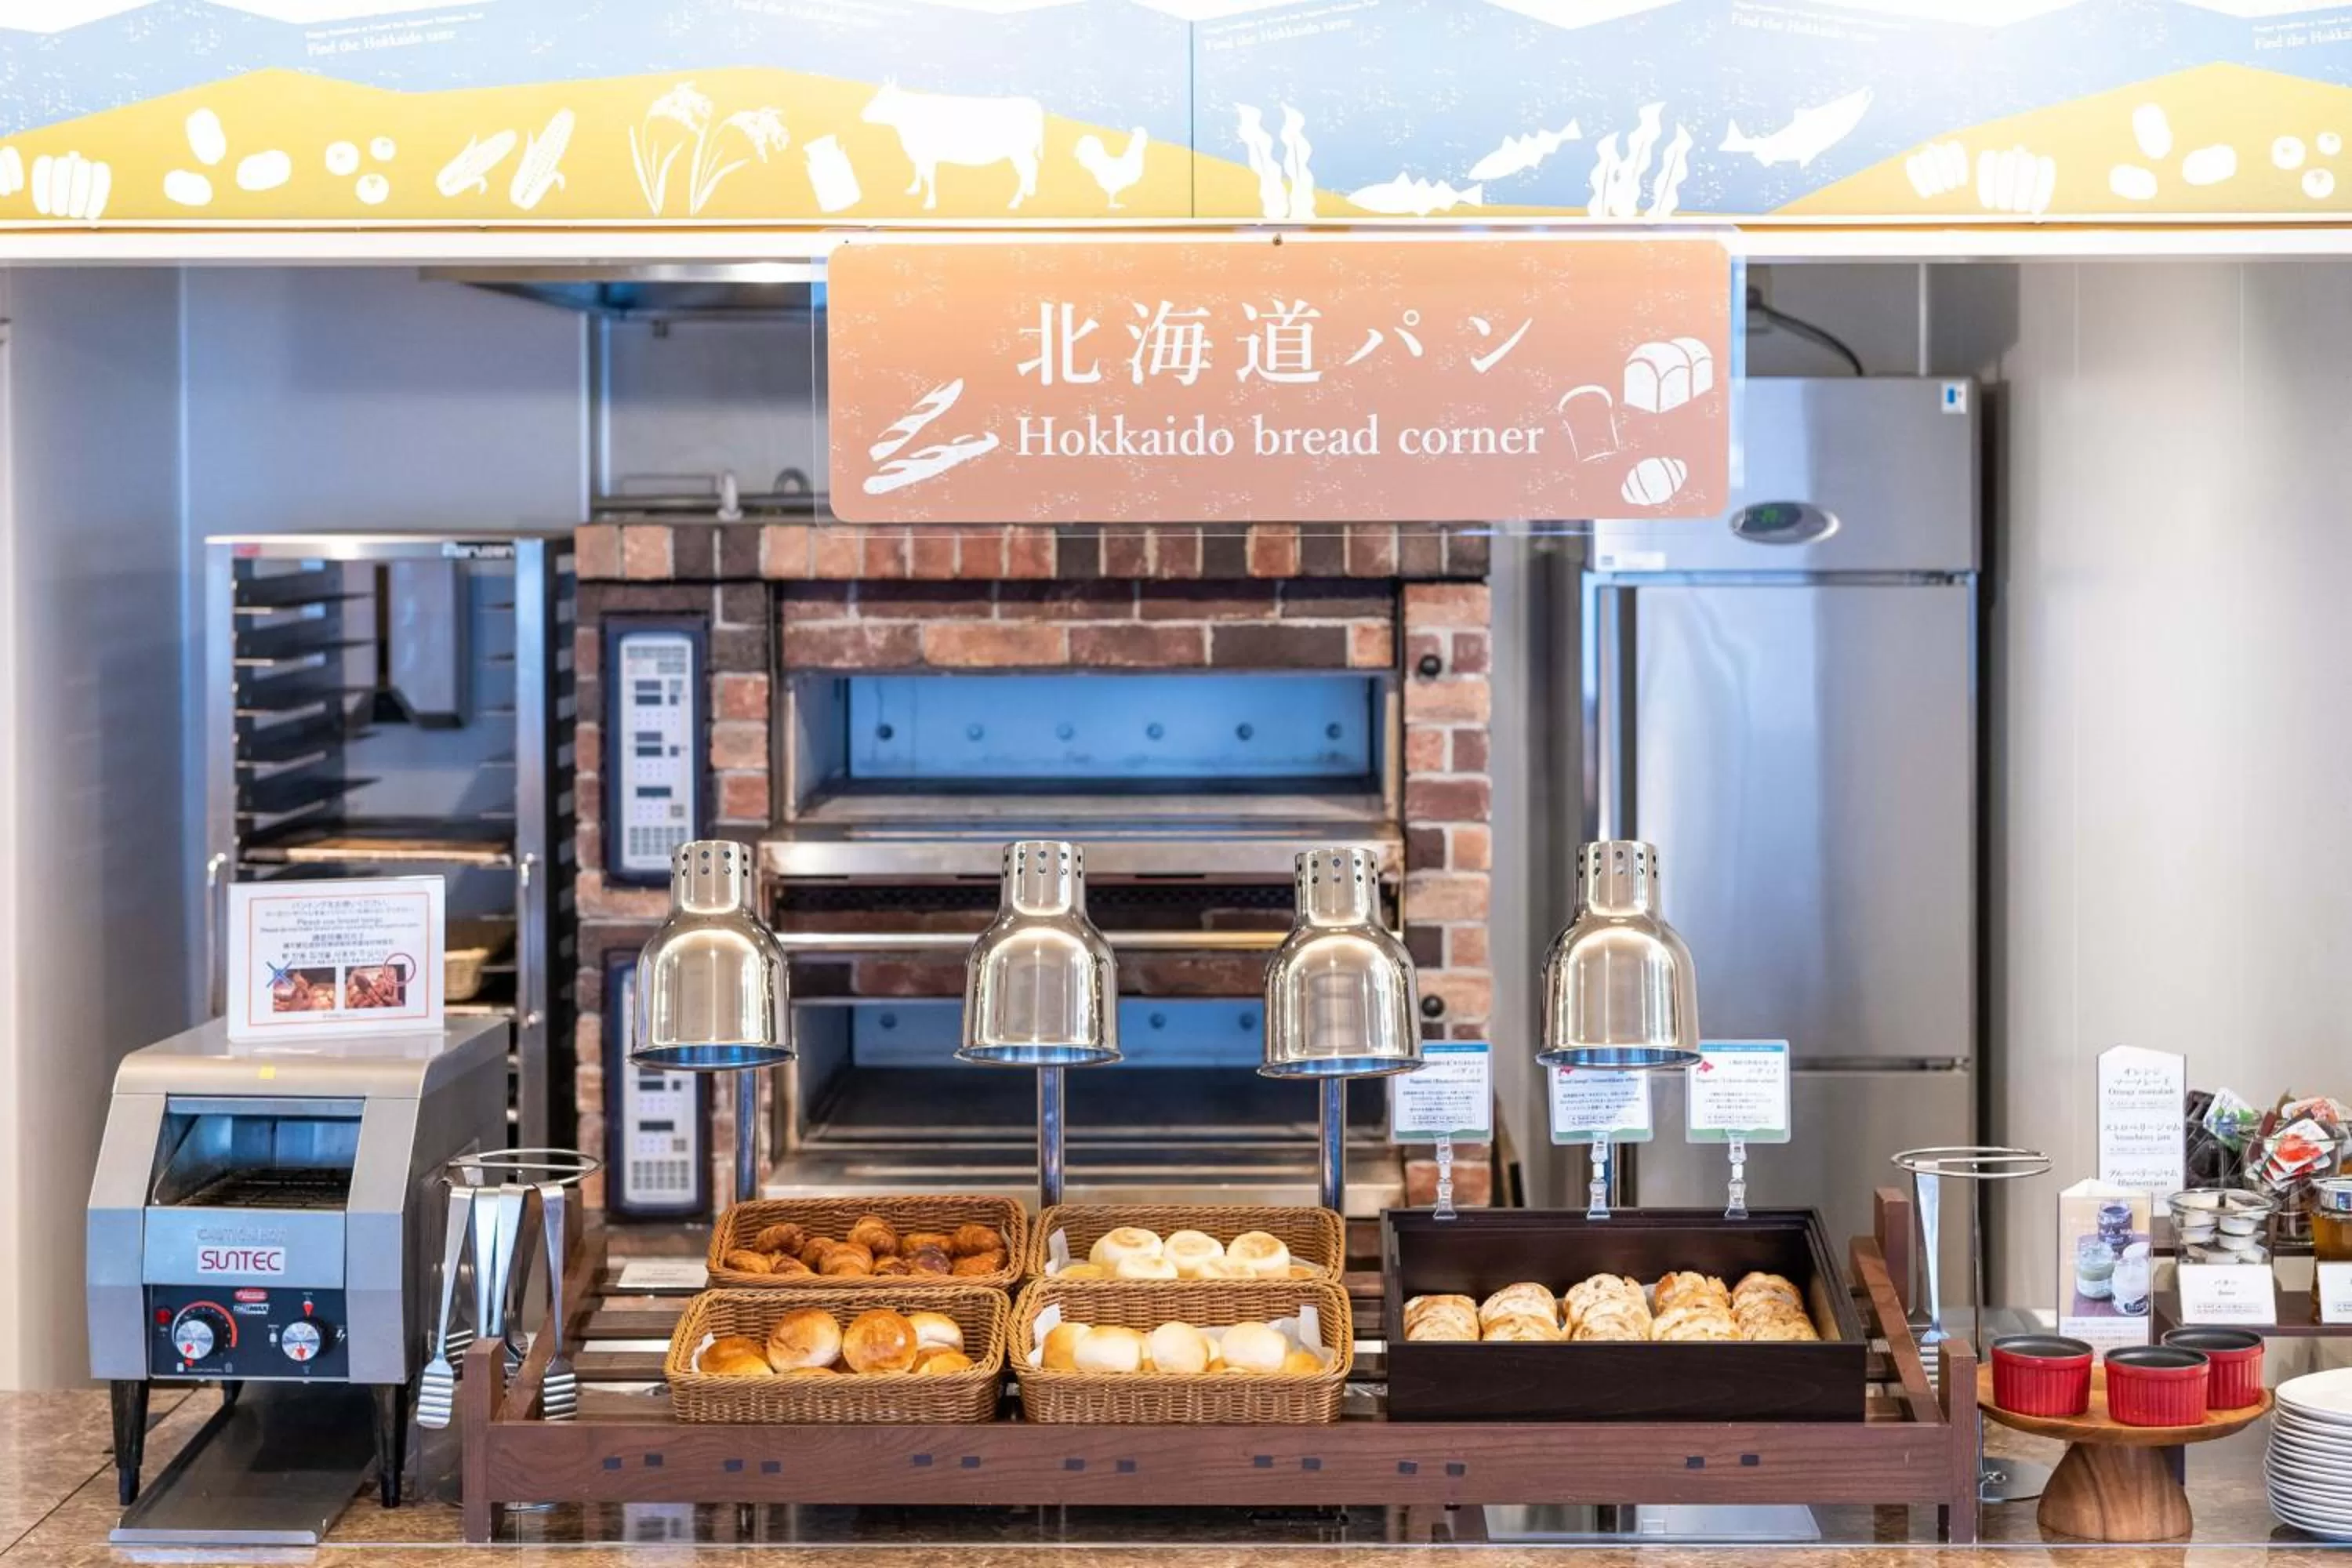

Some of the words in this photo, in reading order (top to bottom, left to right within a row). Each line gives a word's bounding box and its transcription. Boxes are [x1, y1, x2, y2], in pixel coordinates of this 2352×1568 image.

[1016, 298, 1533, 387] 北海道パン
[1016, 415, 1235, 457] Hokkaido
[1254, 414, 1381, 456] bread
[1398, 421, 1545, 456] corner
[201, 1250, 282, 1271] SUNTEC
